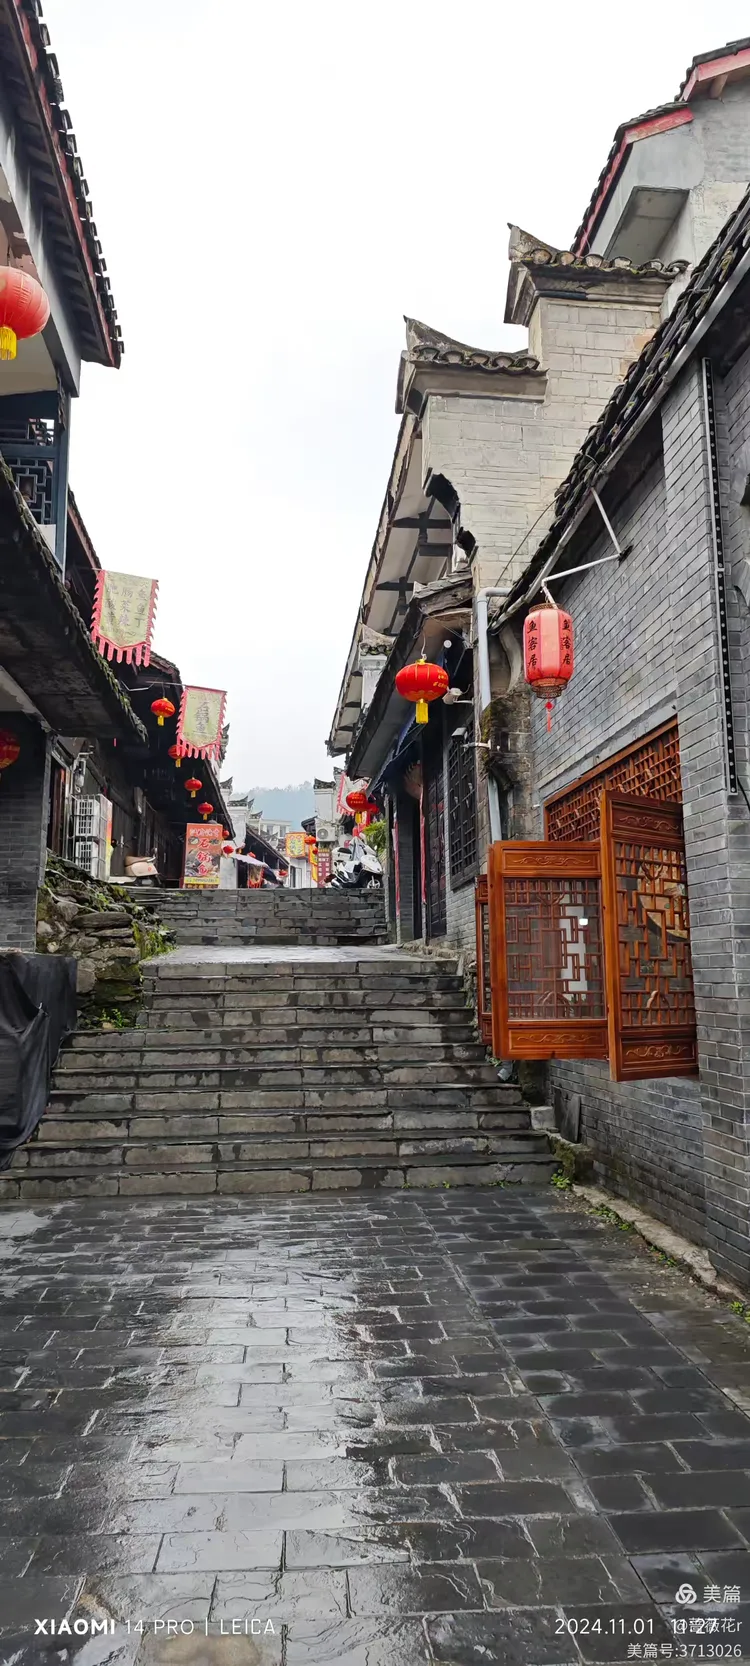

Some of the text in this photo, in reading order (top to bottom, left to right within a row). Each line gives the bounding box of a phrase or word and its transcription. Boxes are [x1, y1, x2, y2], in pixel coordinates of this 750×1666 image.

[527, 620, 538, 668] 鱼客居
[562, 620, 572, 665] 鱼客居
[197, 838, 212, 876] 石锅鱼
